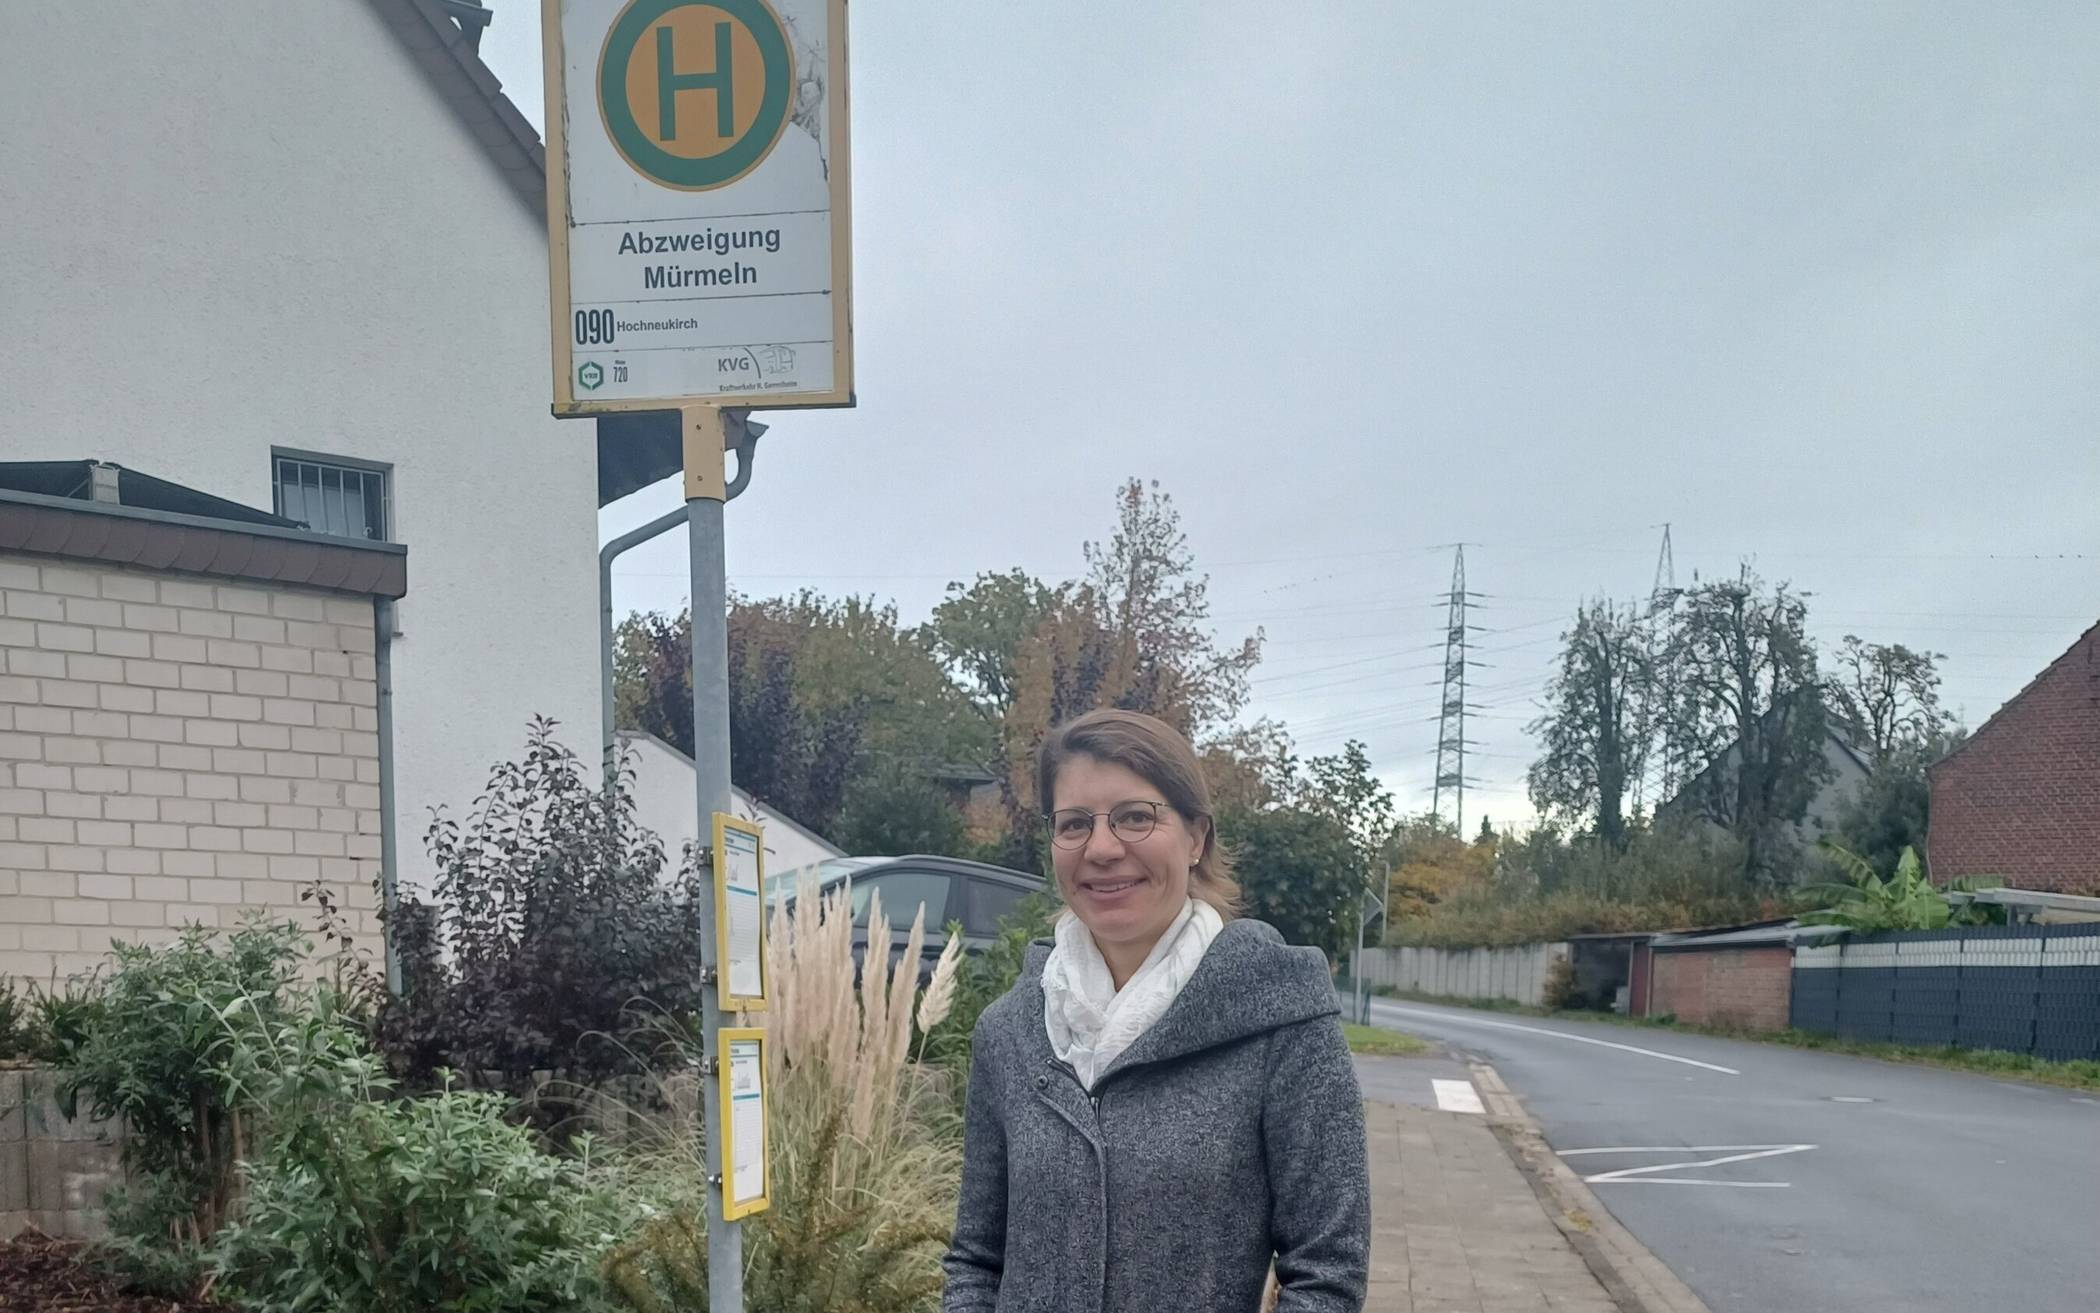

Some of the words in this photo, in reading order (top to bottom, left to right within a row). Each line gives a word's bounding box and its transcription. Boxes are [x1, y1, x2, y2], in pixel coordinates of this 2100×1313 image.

[656, 22, 734, 141] H
[618, 228, 781, 255] Abzweigung
[643, 262, 757, 289] Mürmeln
[575, 309, 615, 345] 090
[616, 318, 698, 332] Hochneukirch
[613, 366, 628, 383] 720
[718, 357, 750, 372] KVG
